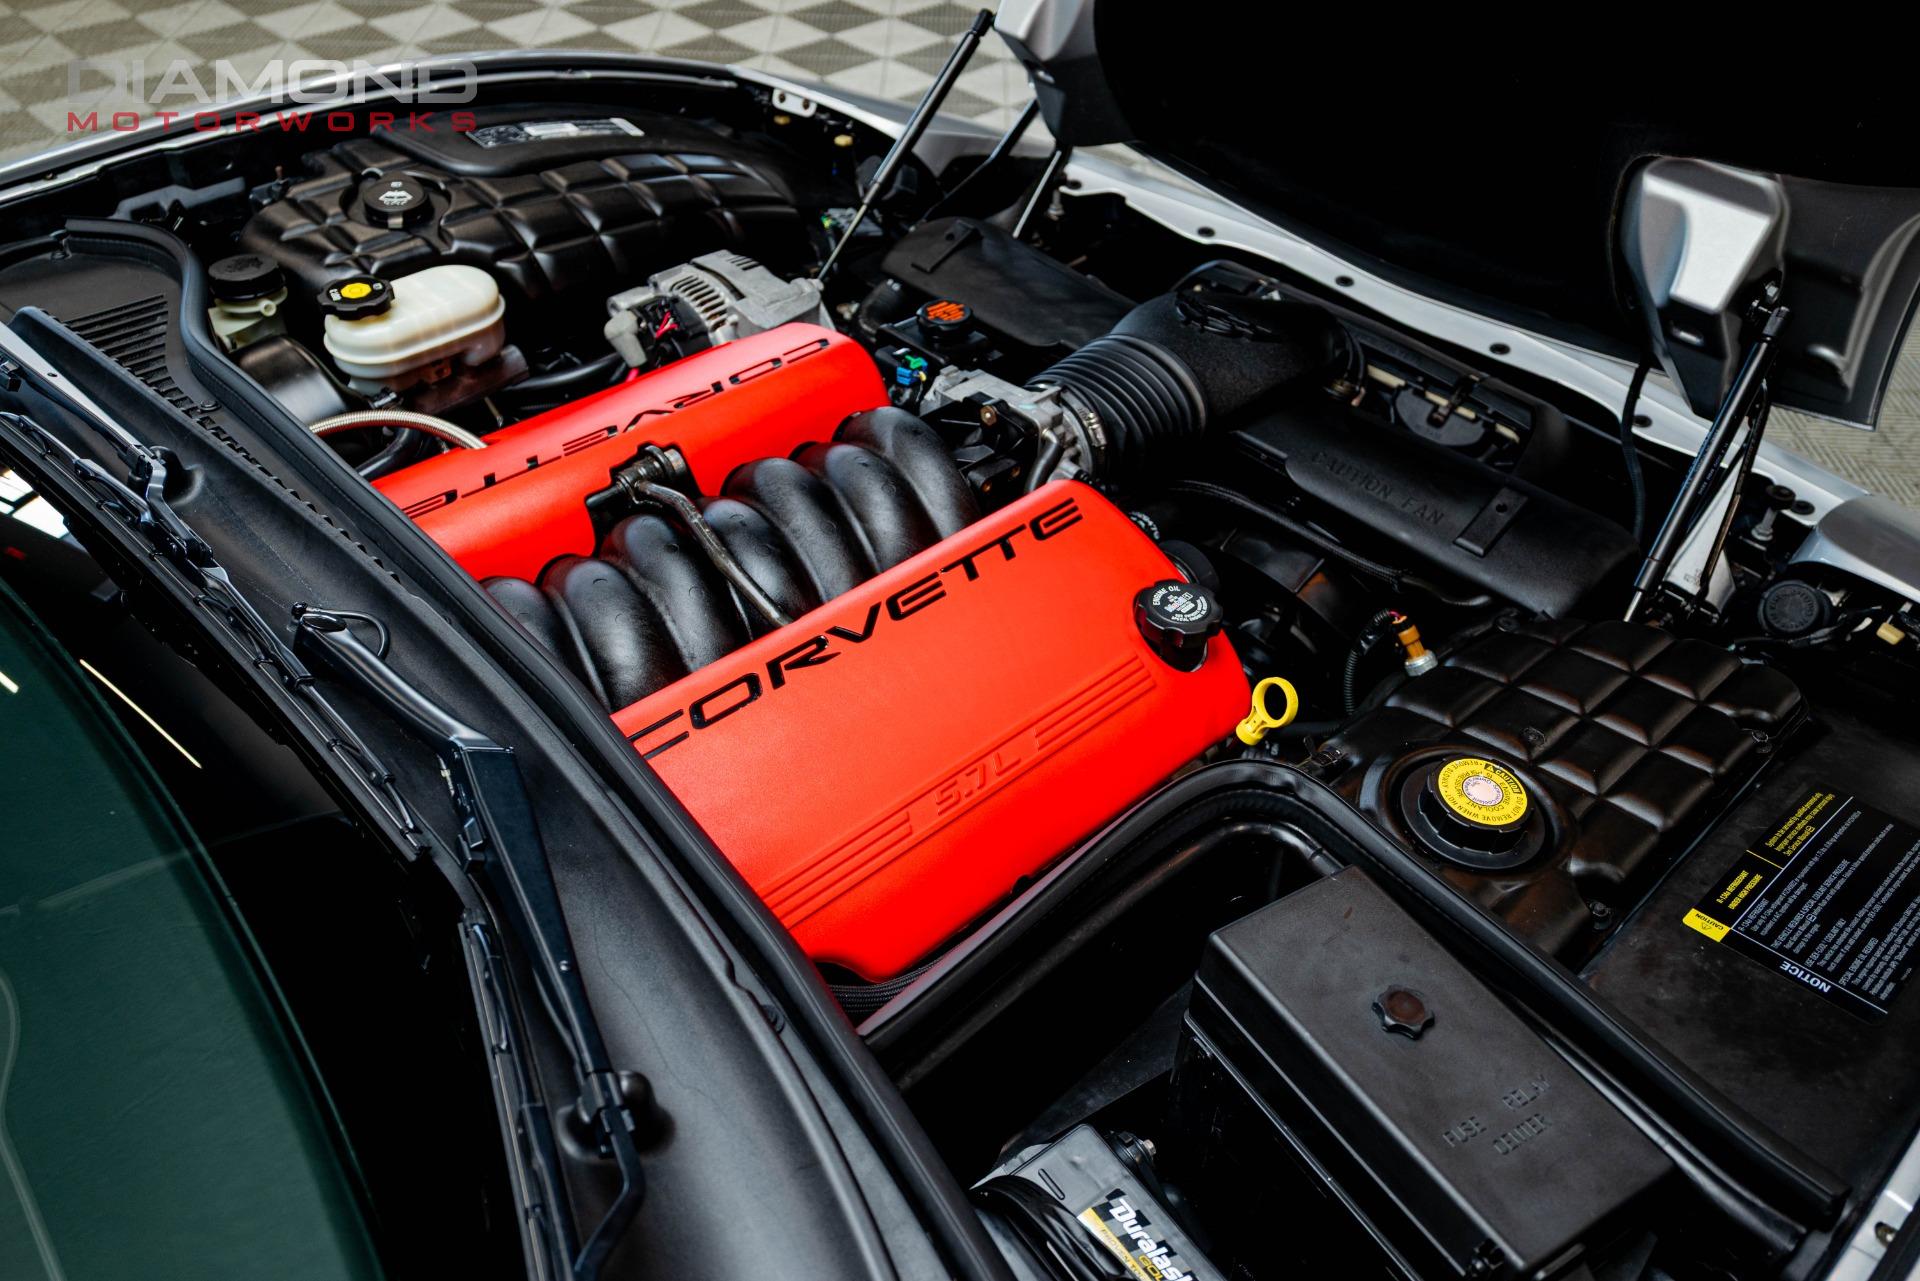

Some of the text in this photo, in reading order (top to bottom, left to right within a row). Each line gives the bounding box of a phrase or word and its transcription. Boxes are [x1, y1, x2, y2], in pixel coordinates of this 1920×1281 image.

[1311, 450, 1445, 525] CAUTION FAN
[627, 497, 1083, 760] CORVETTE
[935, 751, 1022, 816] 5.7L
[1495, 769, 1521, 794] CAUTION
[1456, 805, 1479, 819] WHEN
[1466, 800, 1505, 812] COOLANT
[1482, 814, 1513, 823] REMOVE
[1695, 912, 1725, 931] CAUTION
[1779, 960, 1831, 993] NOTICE
[1442, 1074, 1552, 1148] FUSE RELAY
[1493, 1113, 1552, 1155] CENTER
[1109, 1198, 1193, 1281] Duralas
